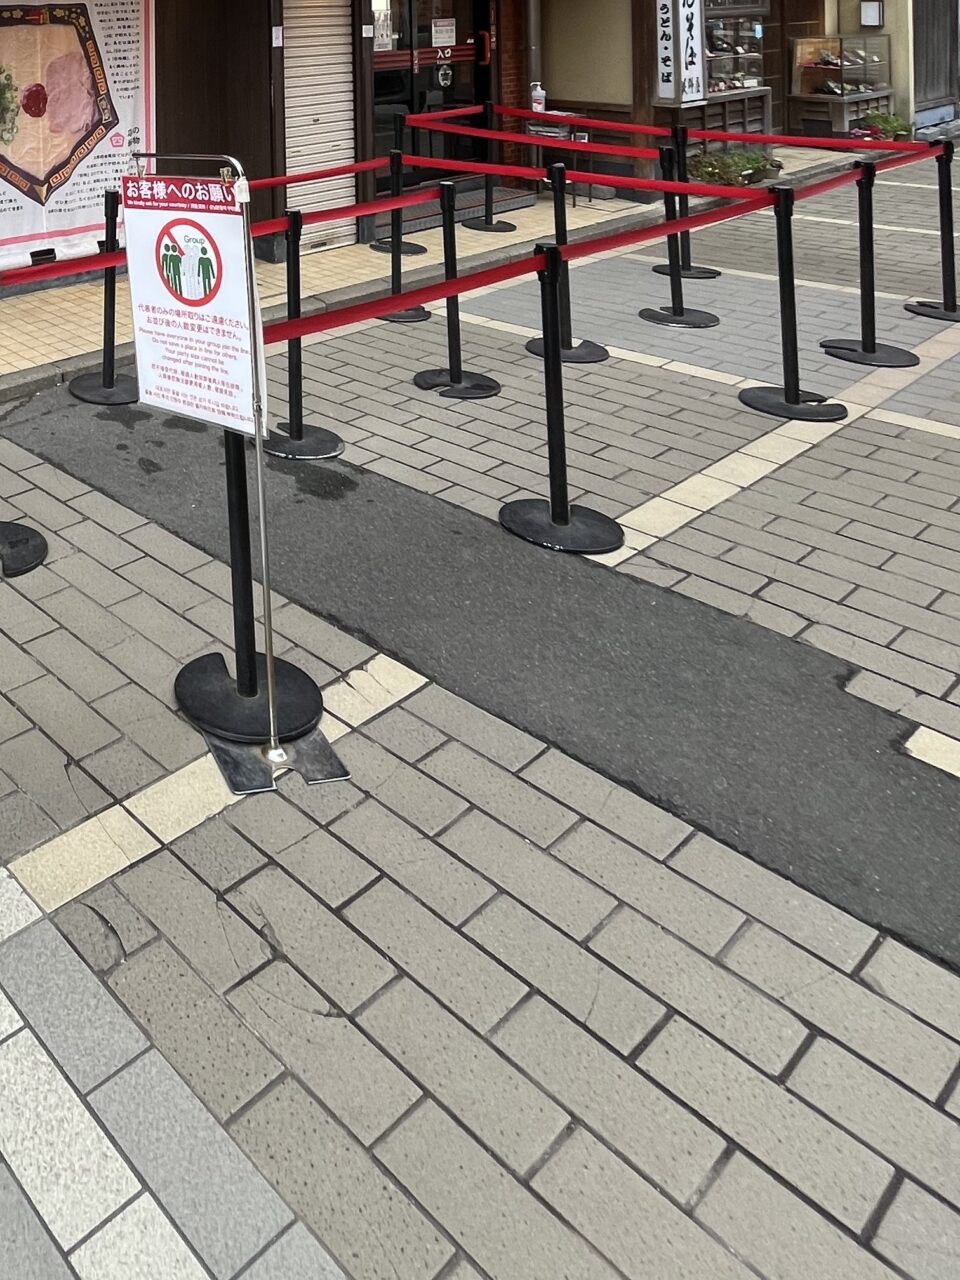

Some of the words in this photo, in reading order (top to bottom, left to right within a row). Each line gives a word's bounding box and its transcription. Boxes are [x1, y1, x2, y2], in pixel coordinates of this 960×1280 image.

[127, 181, 236, 202] お客様へのお願い
[183, 235, 205, 245] Group
